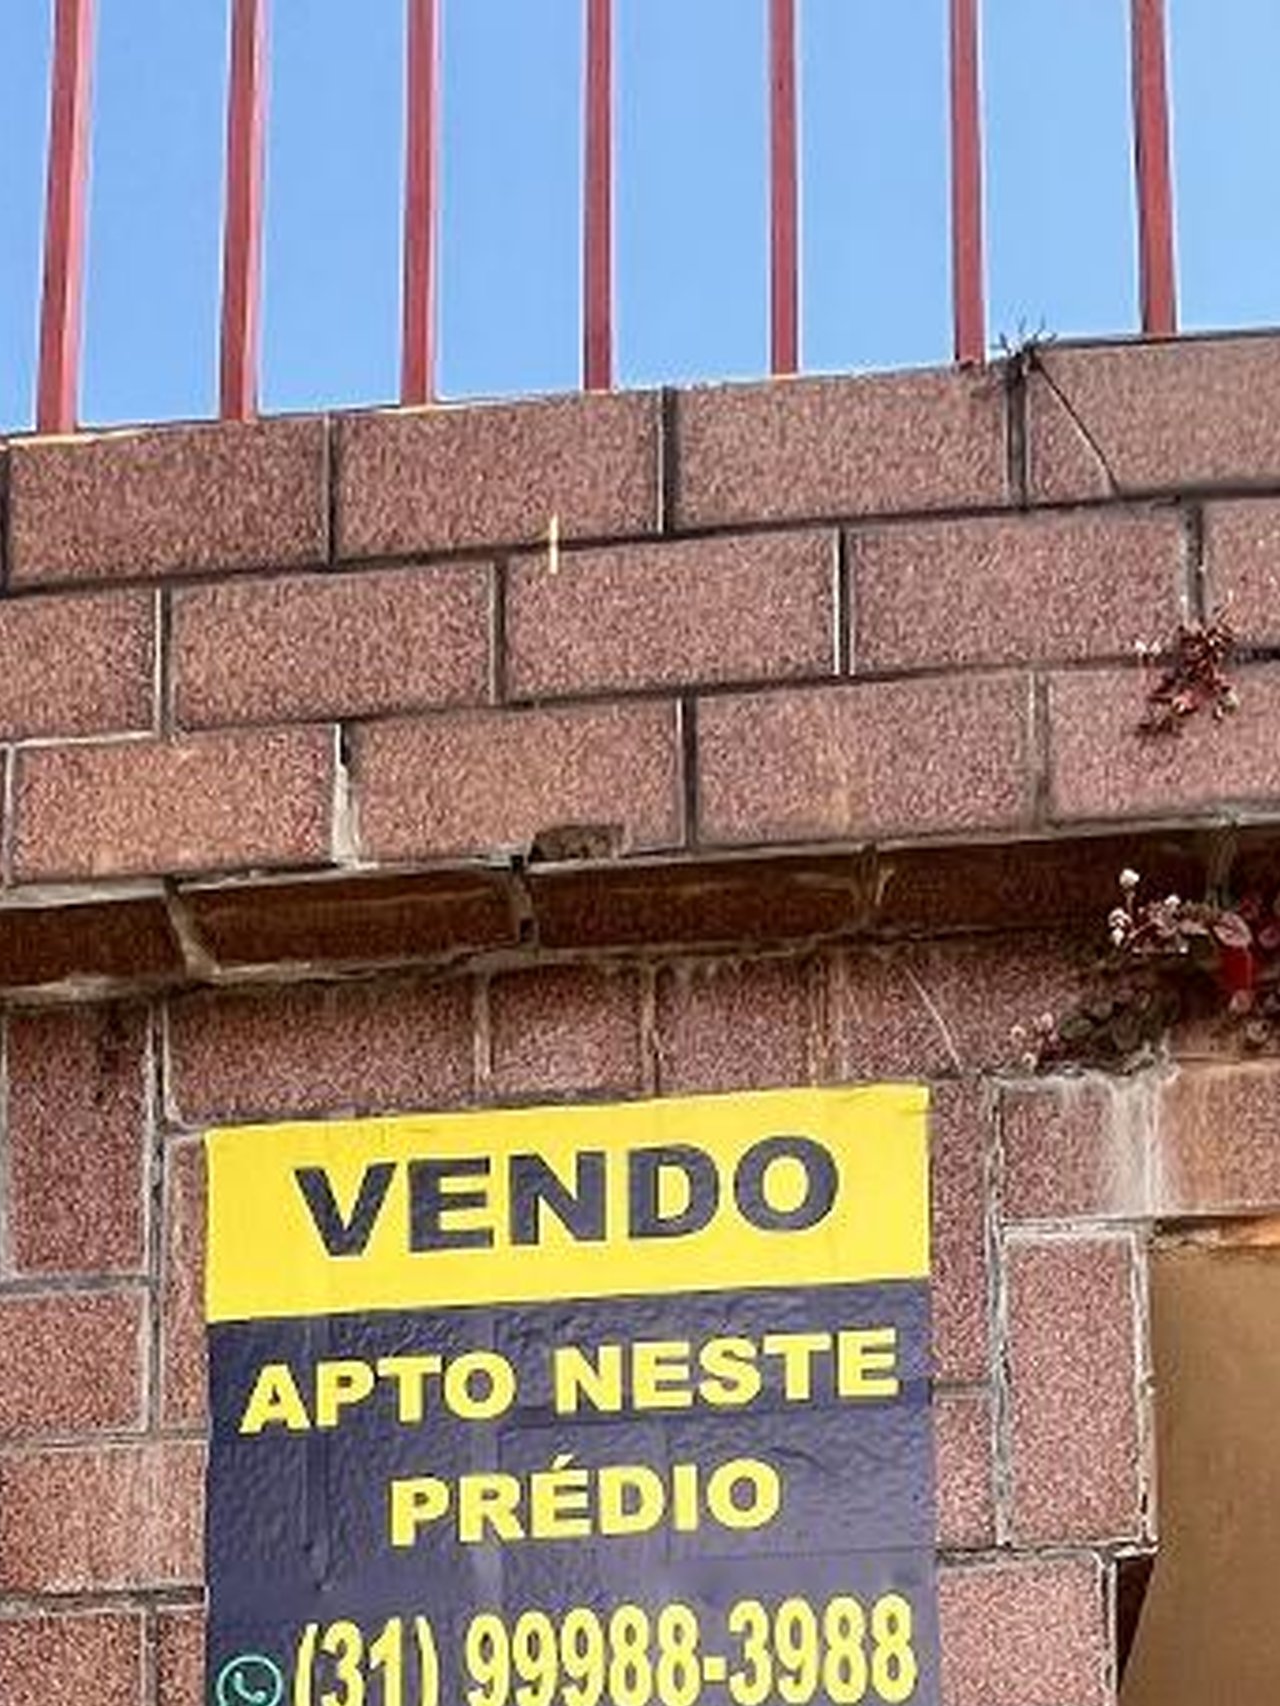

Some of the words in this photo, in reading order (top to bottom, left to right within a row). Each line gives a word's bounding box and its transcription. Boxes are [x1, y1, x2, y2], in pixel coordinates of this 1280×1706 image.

[294, 1134, 840, 1258] VENDO
[236, 1352, 516, 1435] APTO
[552, 1328, 901, 1414] NESTE
[388, 1453, 782, 1547] PRÉDIO
